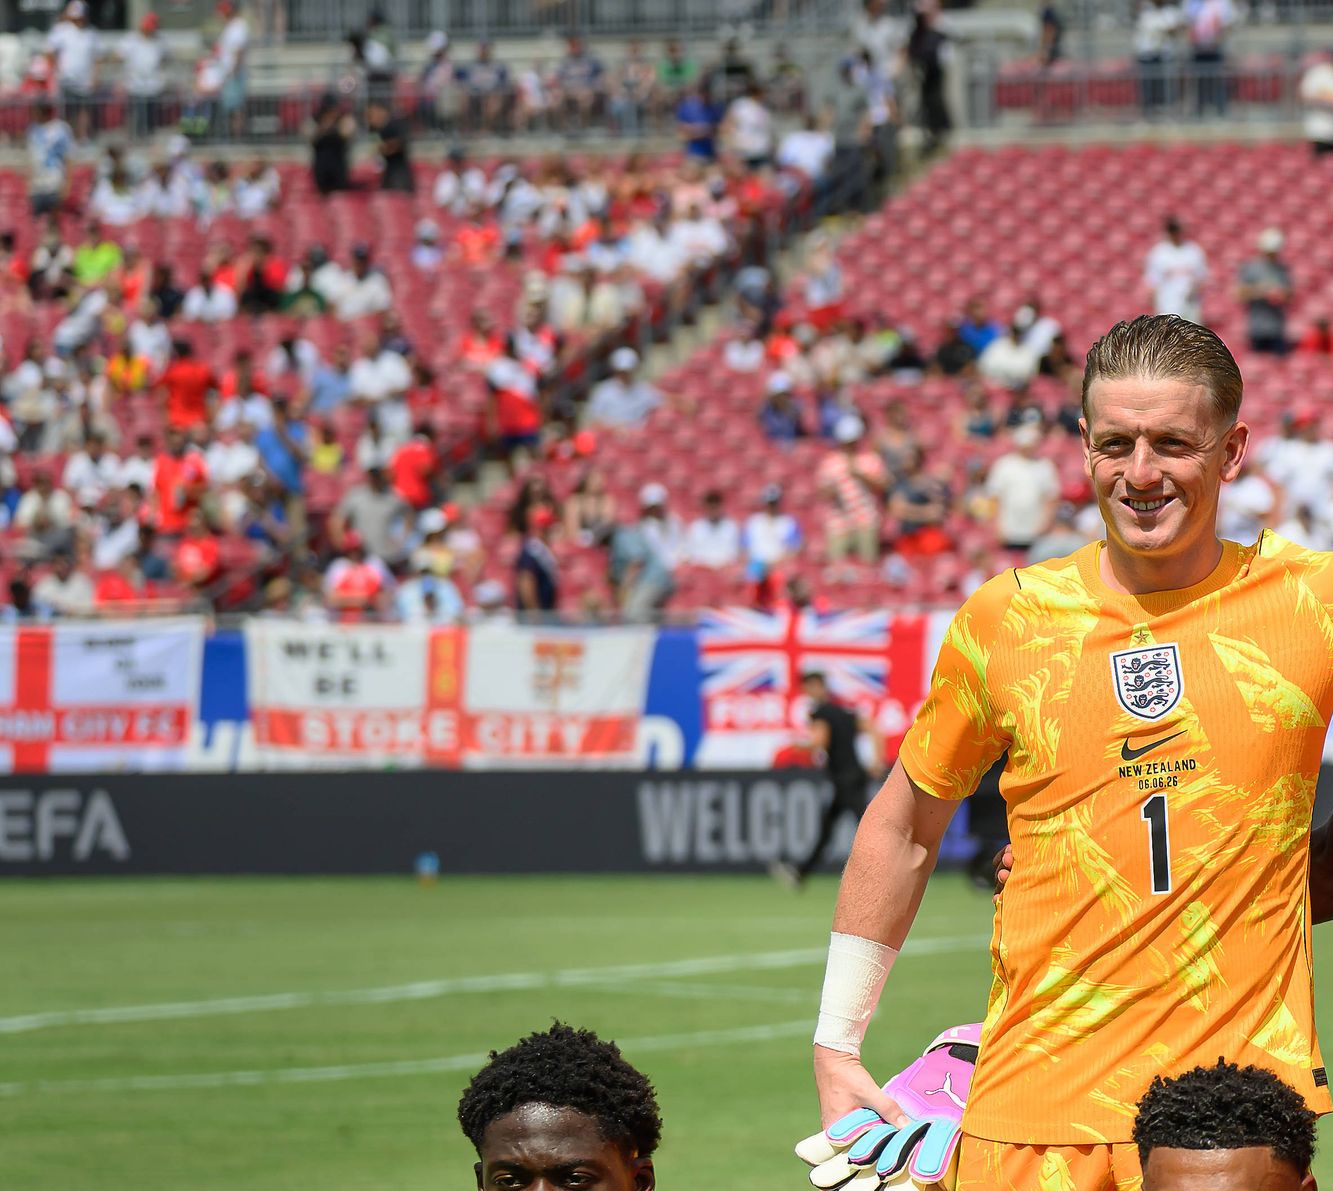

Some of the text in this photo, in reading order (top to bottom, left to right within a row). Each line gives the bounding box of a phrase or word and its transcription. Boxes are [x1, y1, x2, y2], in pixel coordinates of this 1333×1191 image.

[303, 710, 584, 751] STOKE CITY
[1118, 758, 1197, 779] NEW ZEALAND
[1138, 775, 1178, 791] 06.06.26
[640, 780, 858, 863] WELCO
[1140, 793, 1171, 895] 1
